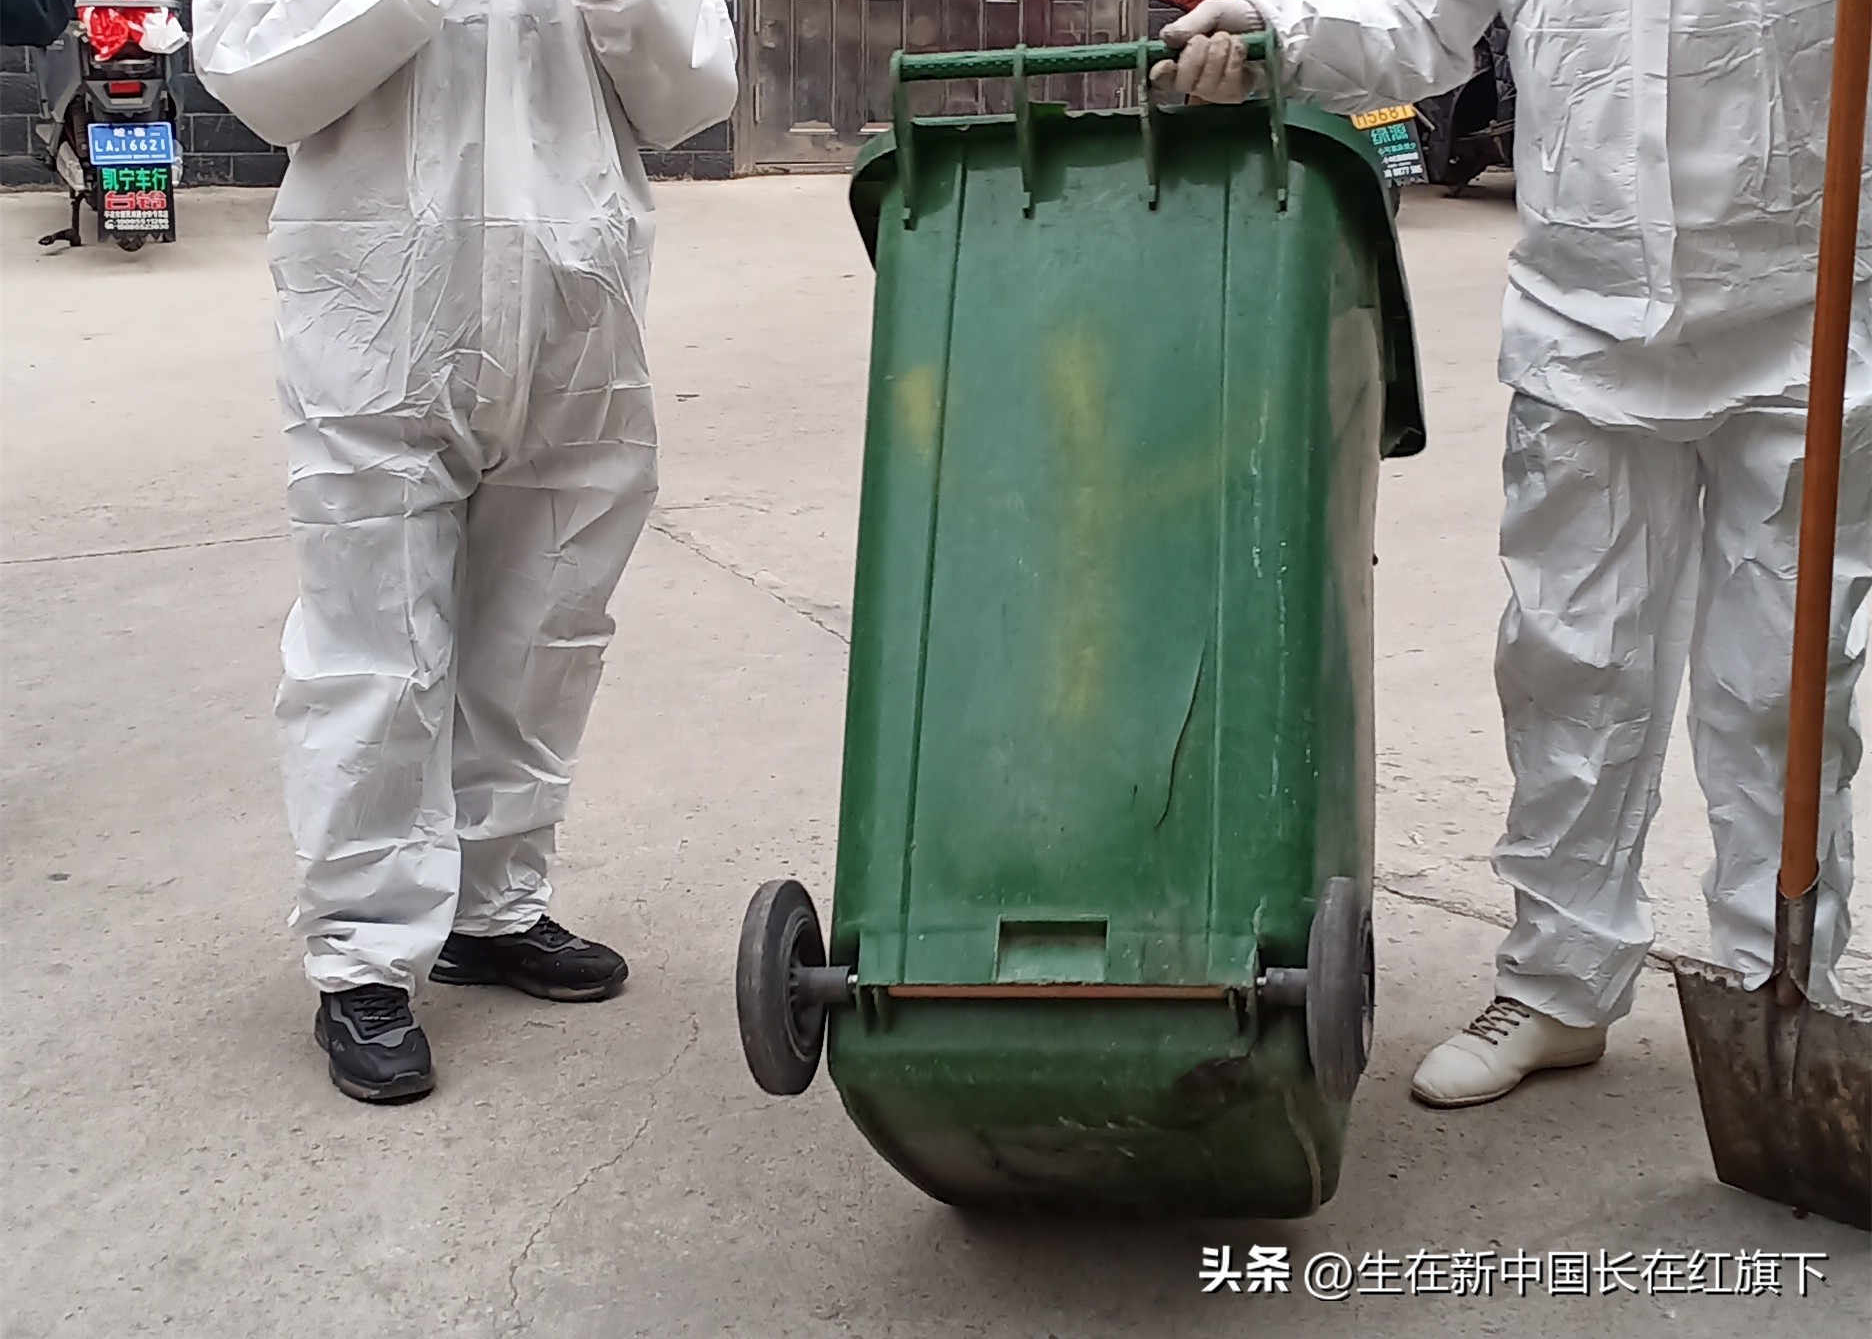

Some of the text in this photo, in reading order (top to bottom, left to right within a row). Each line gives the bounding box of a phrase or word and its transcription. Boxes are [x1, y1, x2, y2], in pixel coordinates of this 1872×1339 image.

[102, 167, 168, 191] 凯宁车行
[104, 190, 167, 211] 台铃
